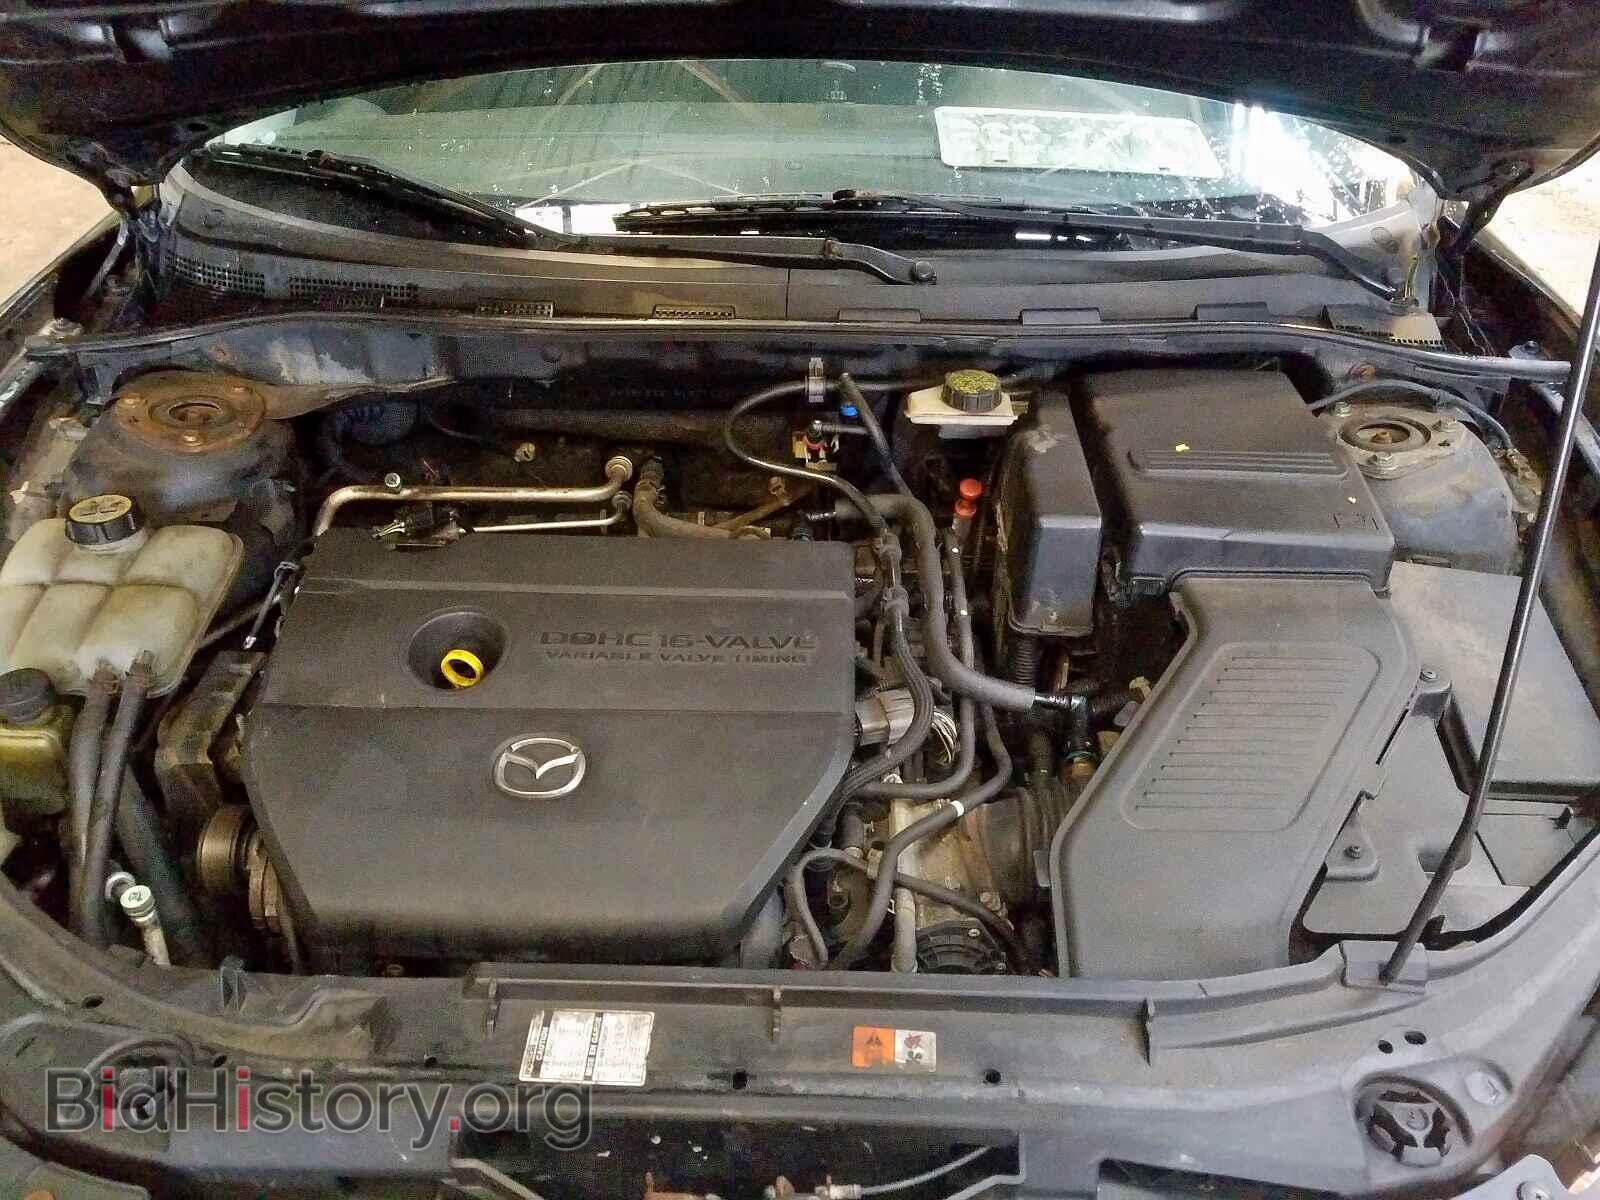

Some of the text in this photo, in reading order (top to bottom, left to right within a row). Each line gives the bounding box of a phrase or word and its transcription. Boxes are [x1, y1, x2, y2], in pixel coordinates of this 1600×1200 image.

[540, 630, 816, 649] DOHC 16-VALVE
[659, 652, 726, 663] VALVE
